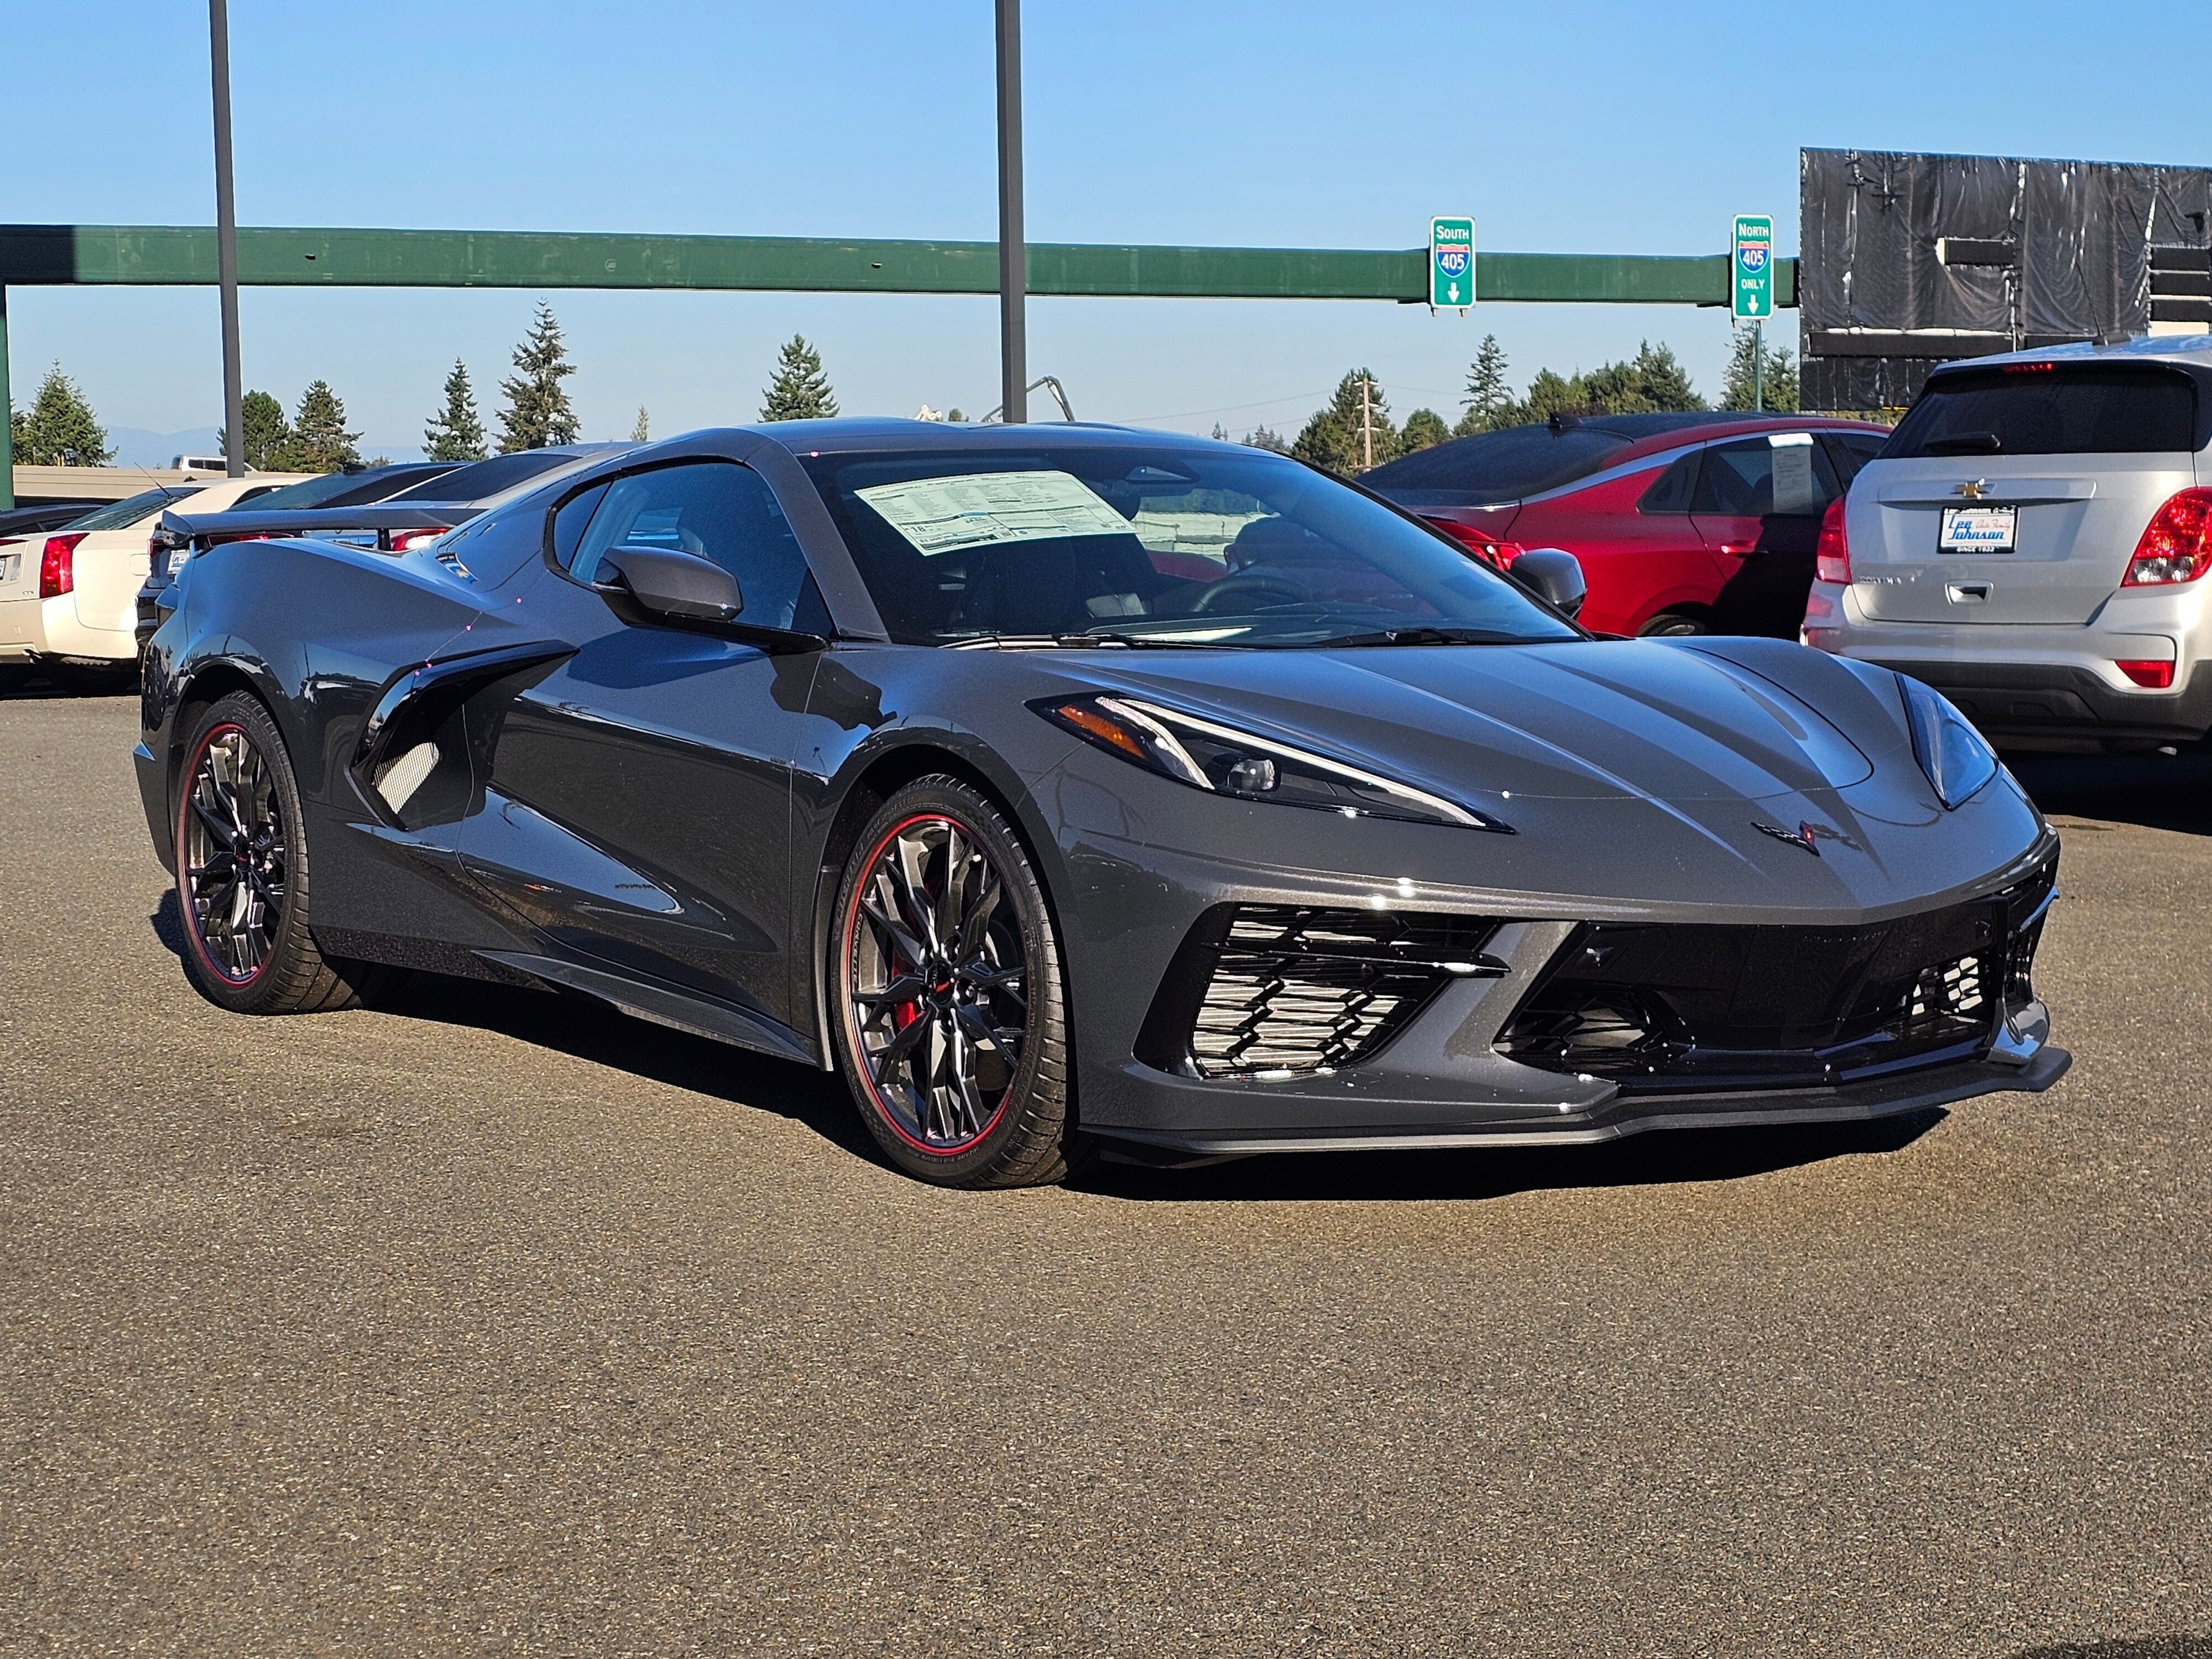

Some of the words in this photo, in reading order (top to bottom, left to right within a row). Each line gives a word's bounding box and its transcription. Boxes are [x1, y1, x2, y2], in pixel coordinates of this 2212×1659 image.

[1436, 225, 1469, 239] SOUTH
[1738, 223, 1769, 237] NORTH
[1441, 254, 1465, 270] 405
[1743, 250, 1764, 266] 405
[1741, 279, 1765, 289] ONLY
[1948, 514, 1973, 529] Lee
[1948, 526, 2005, 540] Johnson
